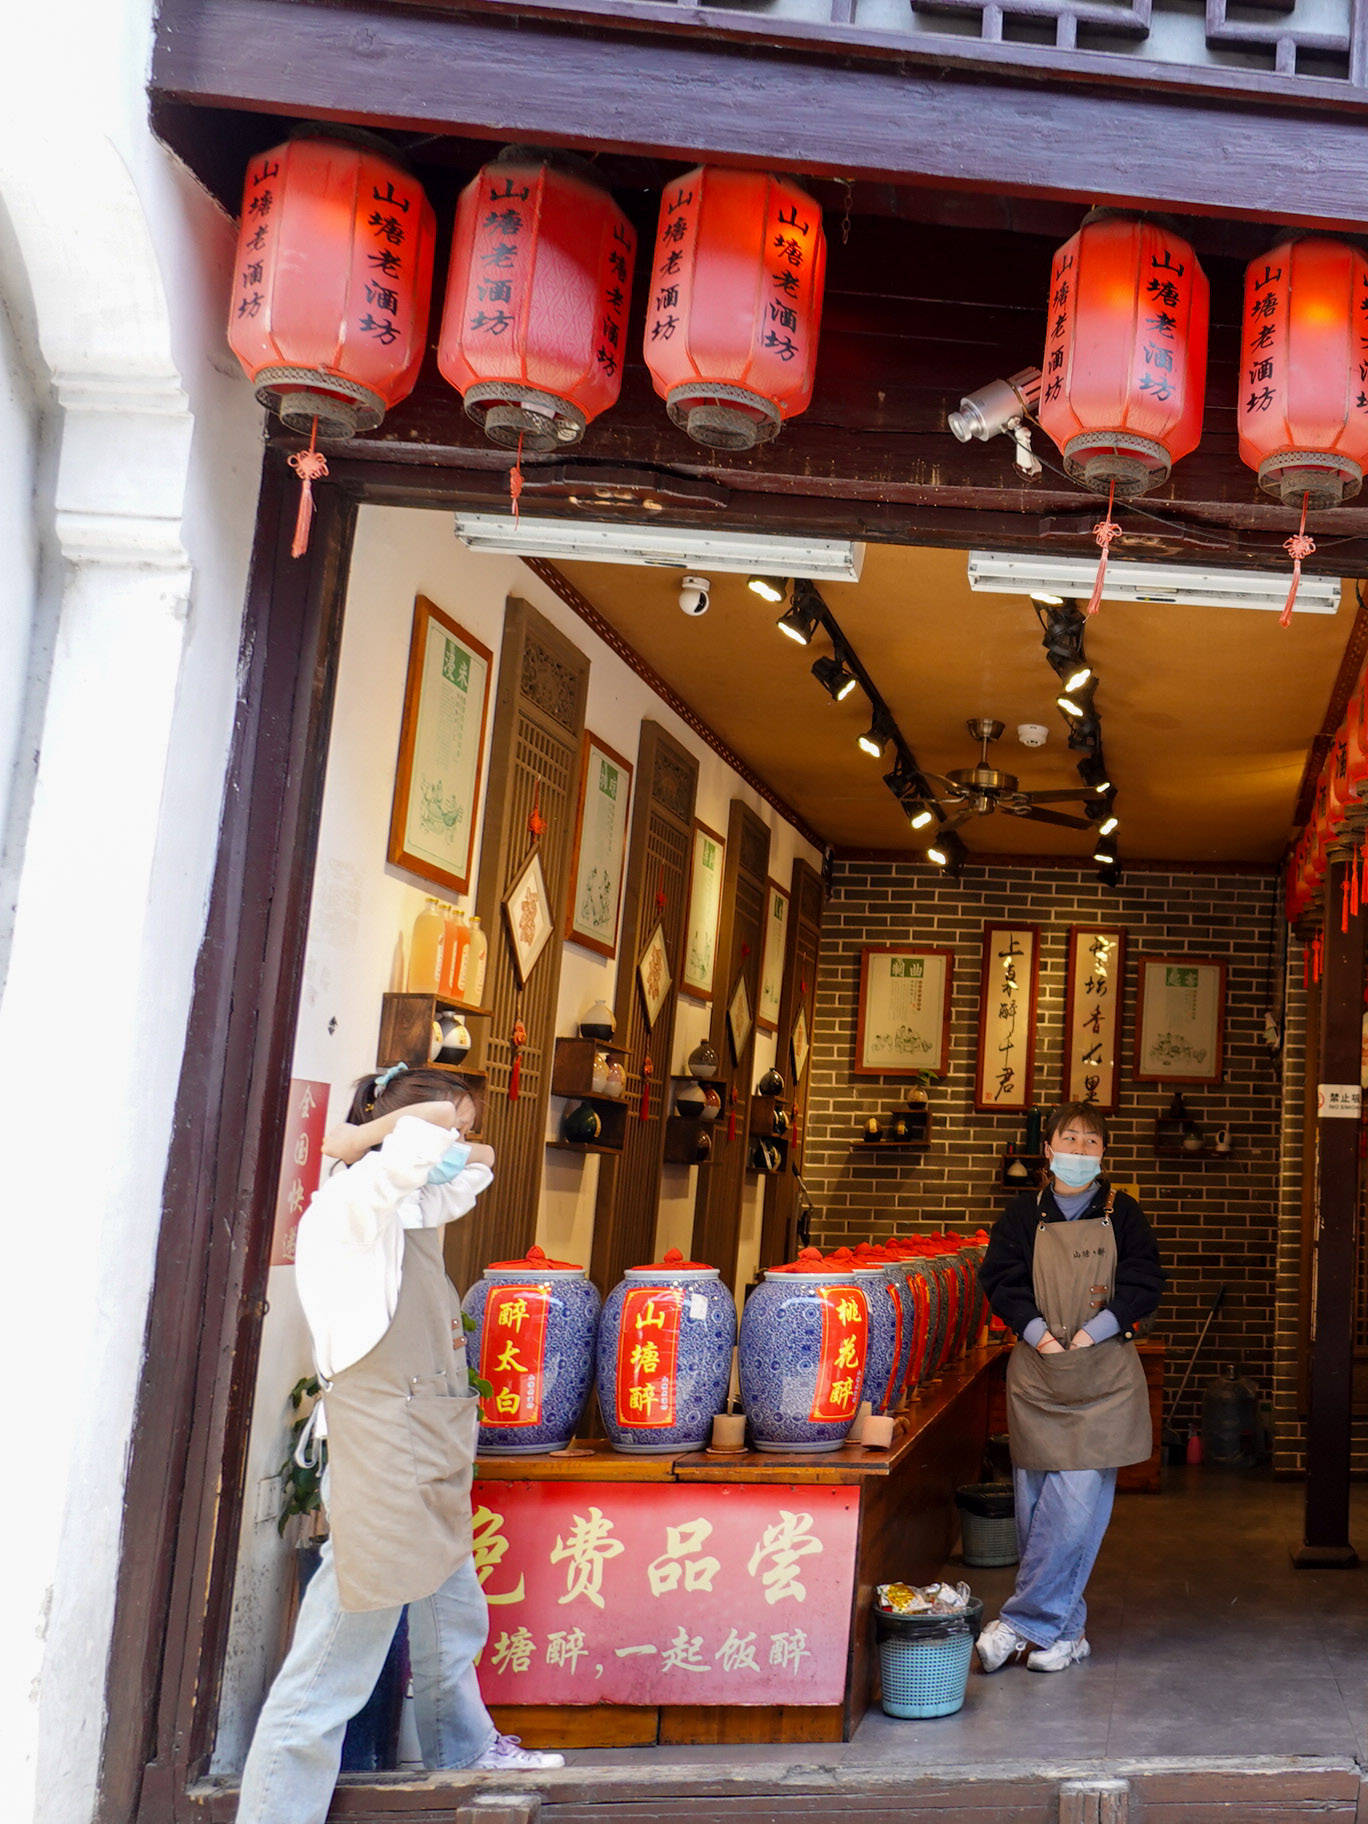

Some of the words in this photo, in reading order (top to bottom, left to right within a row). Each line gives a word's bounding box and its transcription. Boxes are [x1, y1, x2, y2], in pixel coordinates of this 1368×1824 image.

[238, 160, 279, 320] 山塘老酒坊
[359, 180, 410, 347] 山塘老酒坊
[468, 178, 531, 336] 山塘老酒坊
[597, 221, 632, 379] 山塘老酒坊
[651, 188, 694, 342] 山塘老酒坊
[764, 203, 809, 363] 山塘老酒坊
[1044, 254, 1073, 404] 山塘老酒坊
[1138, 250, 1186, 402] 山塘老酒坊
[1246, 266, 1282, 415] 山塘老酒坊
[493, 1302, 530, 1415] 醉太白
[628, 1302, 666, 1419] 山塘醉
[828, 1297, 863, 1409] 桃花醉
[472, 1504, 824, 1609] 免费品尝
[474, 1626, 812, 1680] 塘醉，一起饭醉
